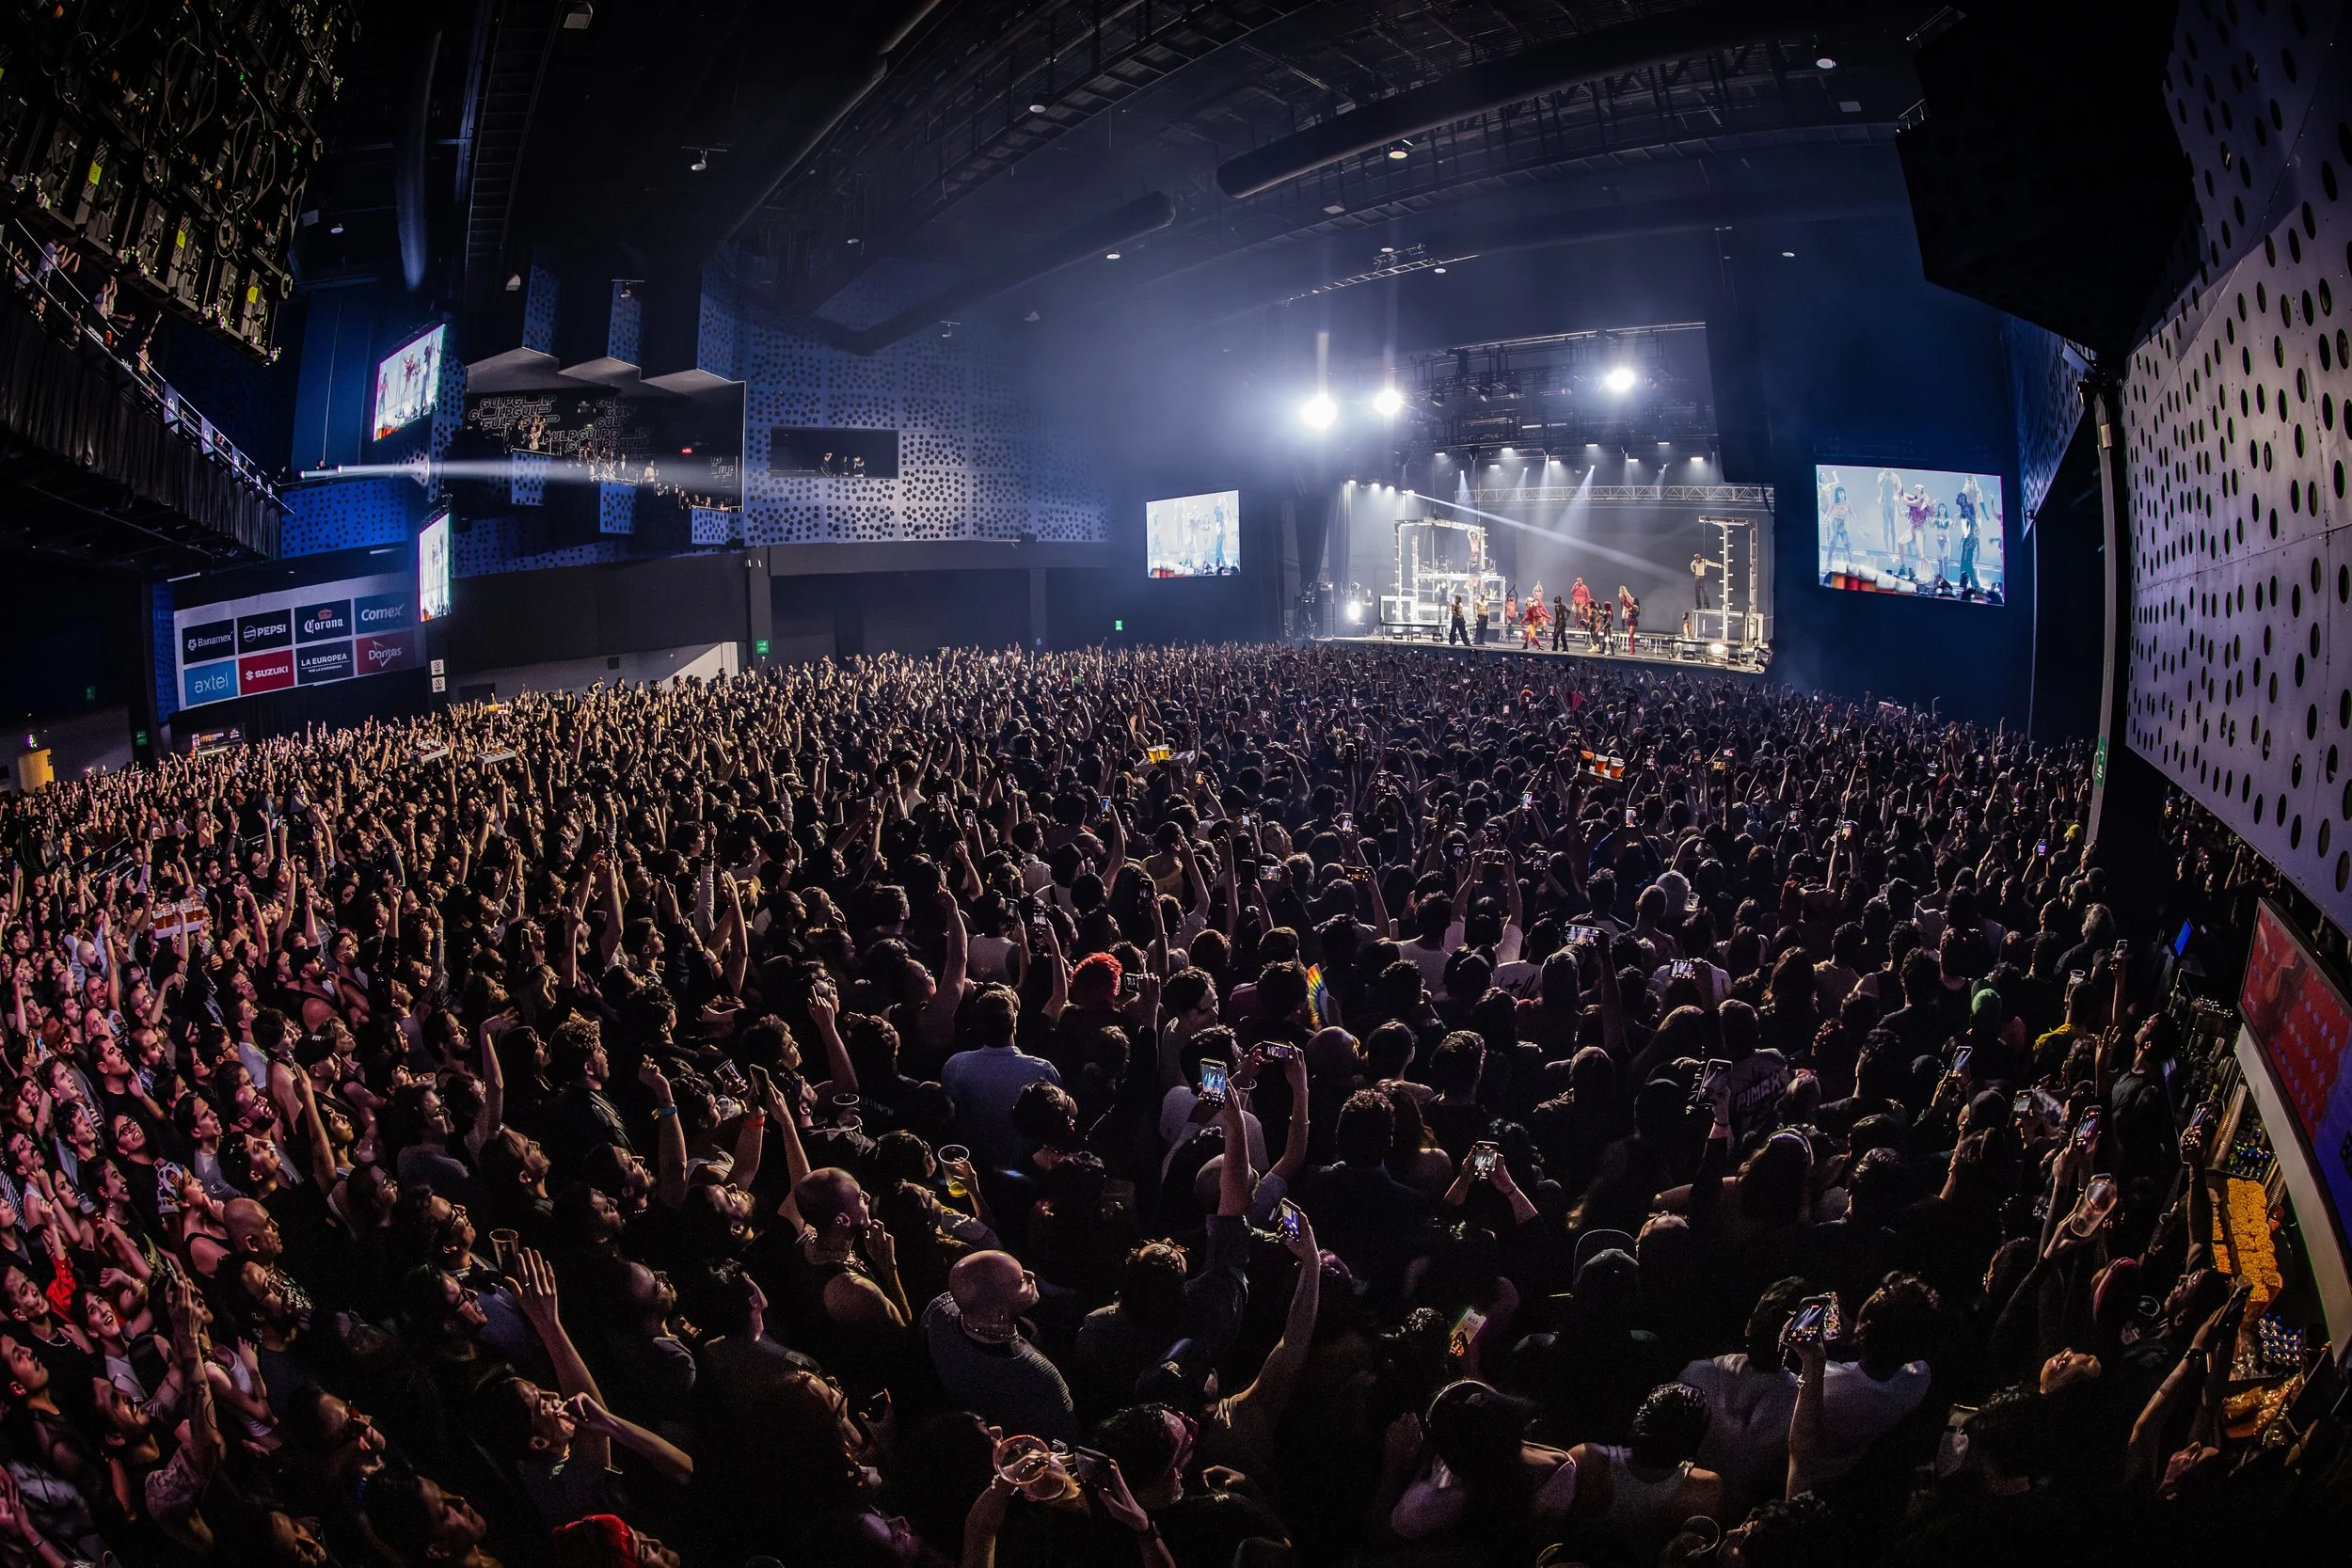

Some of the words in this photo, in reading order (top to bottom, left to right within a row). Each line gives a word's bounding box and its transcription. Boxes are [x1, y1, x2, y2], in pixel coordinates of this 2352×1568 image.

[361, 603, 405, 621] Comex
[257, 624, 286, 637] PEPSI
[304, 618, 343, 634] Corona
[198, 631, 233, 647] Banamex
[301, 658, 311, 667] LA
[311, 653, 347, 665] EUROPEA
[255, 665, 289, 678] SUZUKI
[194, 672, 229, 693] axtel
